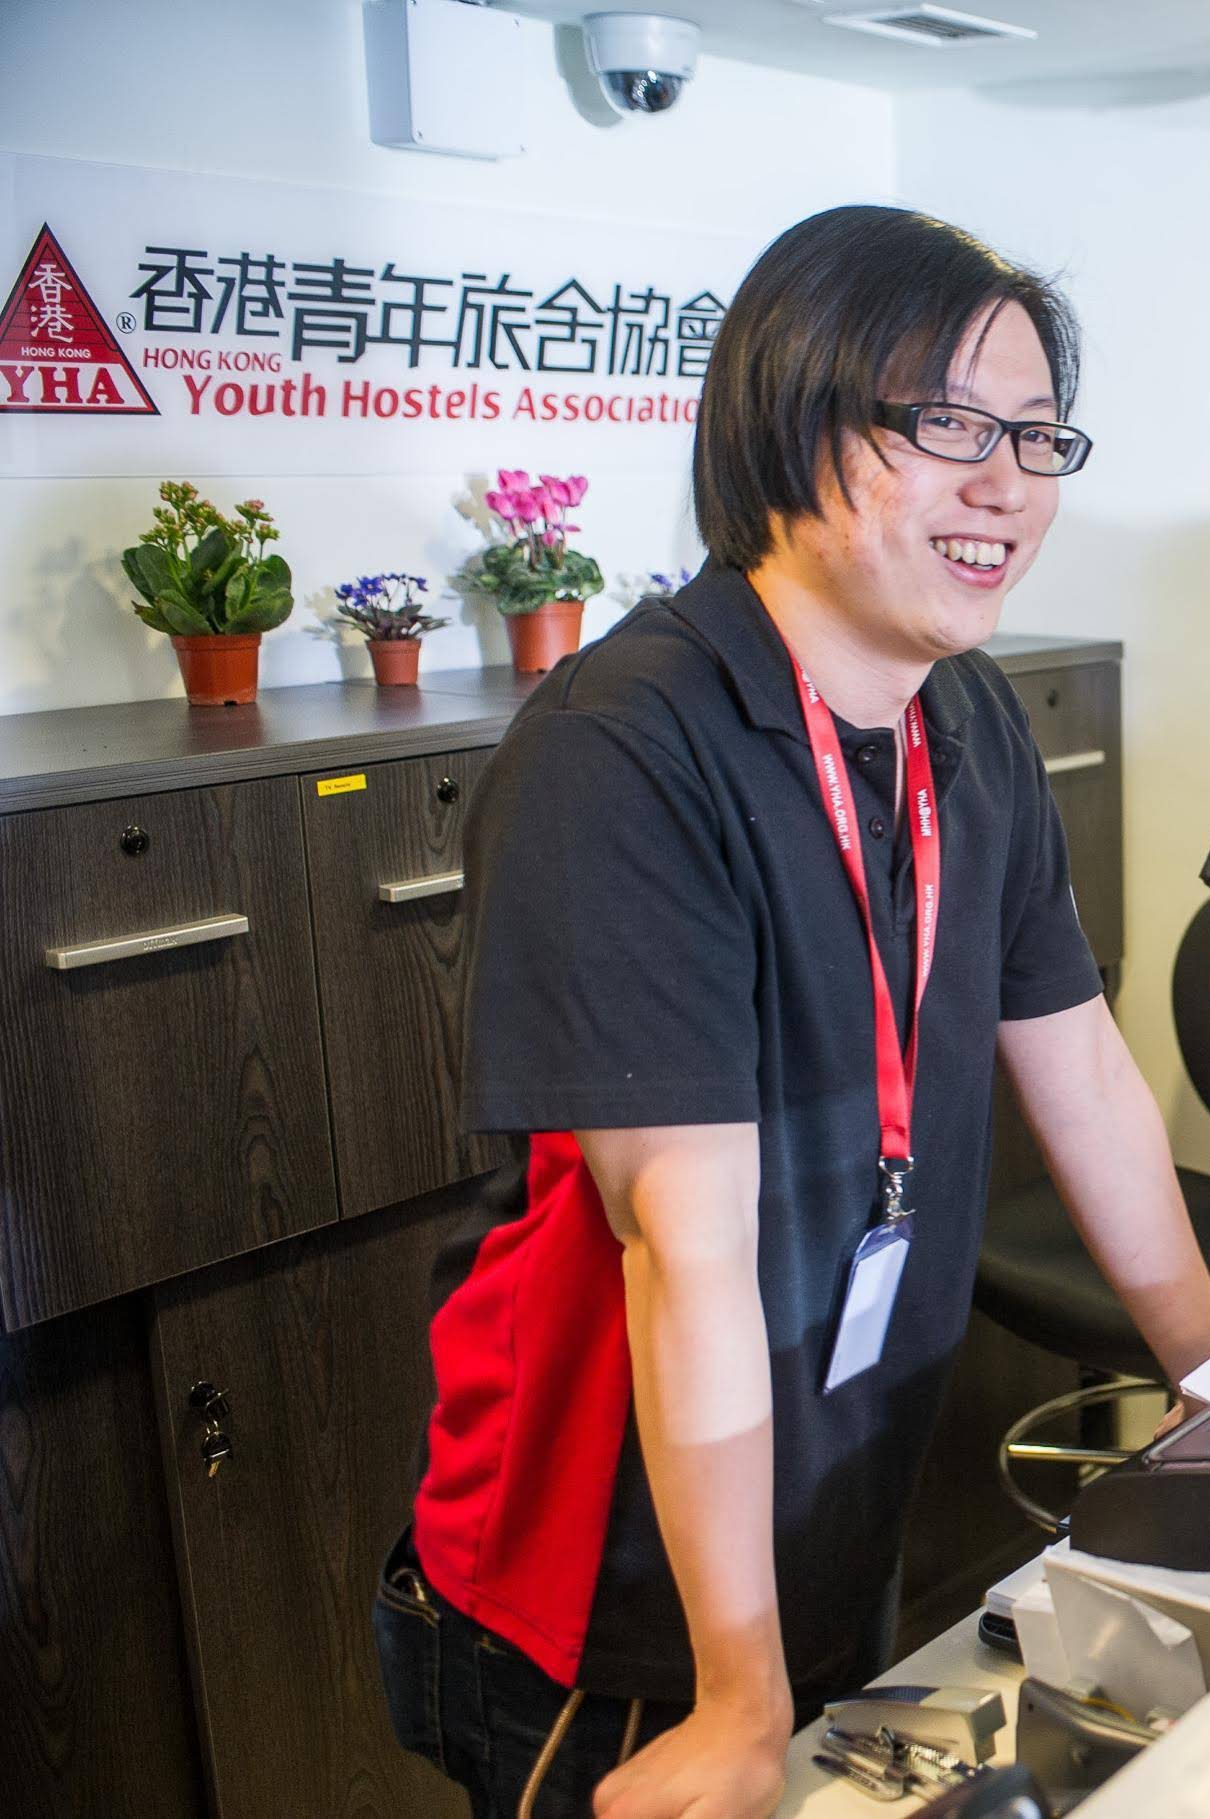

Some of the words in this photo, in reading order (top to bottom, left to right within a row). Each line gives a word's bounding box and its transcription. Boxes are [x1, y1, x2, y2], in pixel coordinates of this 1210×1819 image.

[28, 263, 75, 343] 香港
[130, 245, 728, 377] 香港青年旅舍協會
[21, 346, 55, 358] HONG
[58, 347, 92, 359] KONG
[142, 347, 212, 371] HONG
[217, 350, 283, 373] KONG
[0, 364, 125, 404] YHA
[182, 372, 327, 417] Youth
[341, 380, 502, 420] Hostels
[511, 386, 702, 424] Associatio
[822, 752, 852, 851] WWW.YHA.ORG.HK
[916, 788, 933, 838] MHH@YHA
[921, 883, 935, 978] WWW.YHA.ORG.HK
